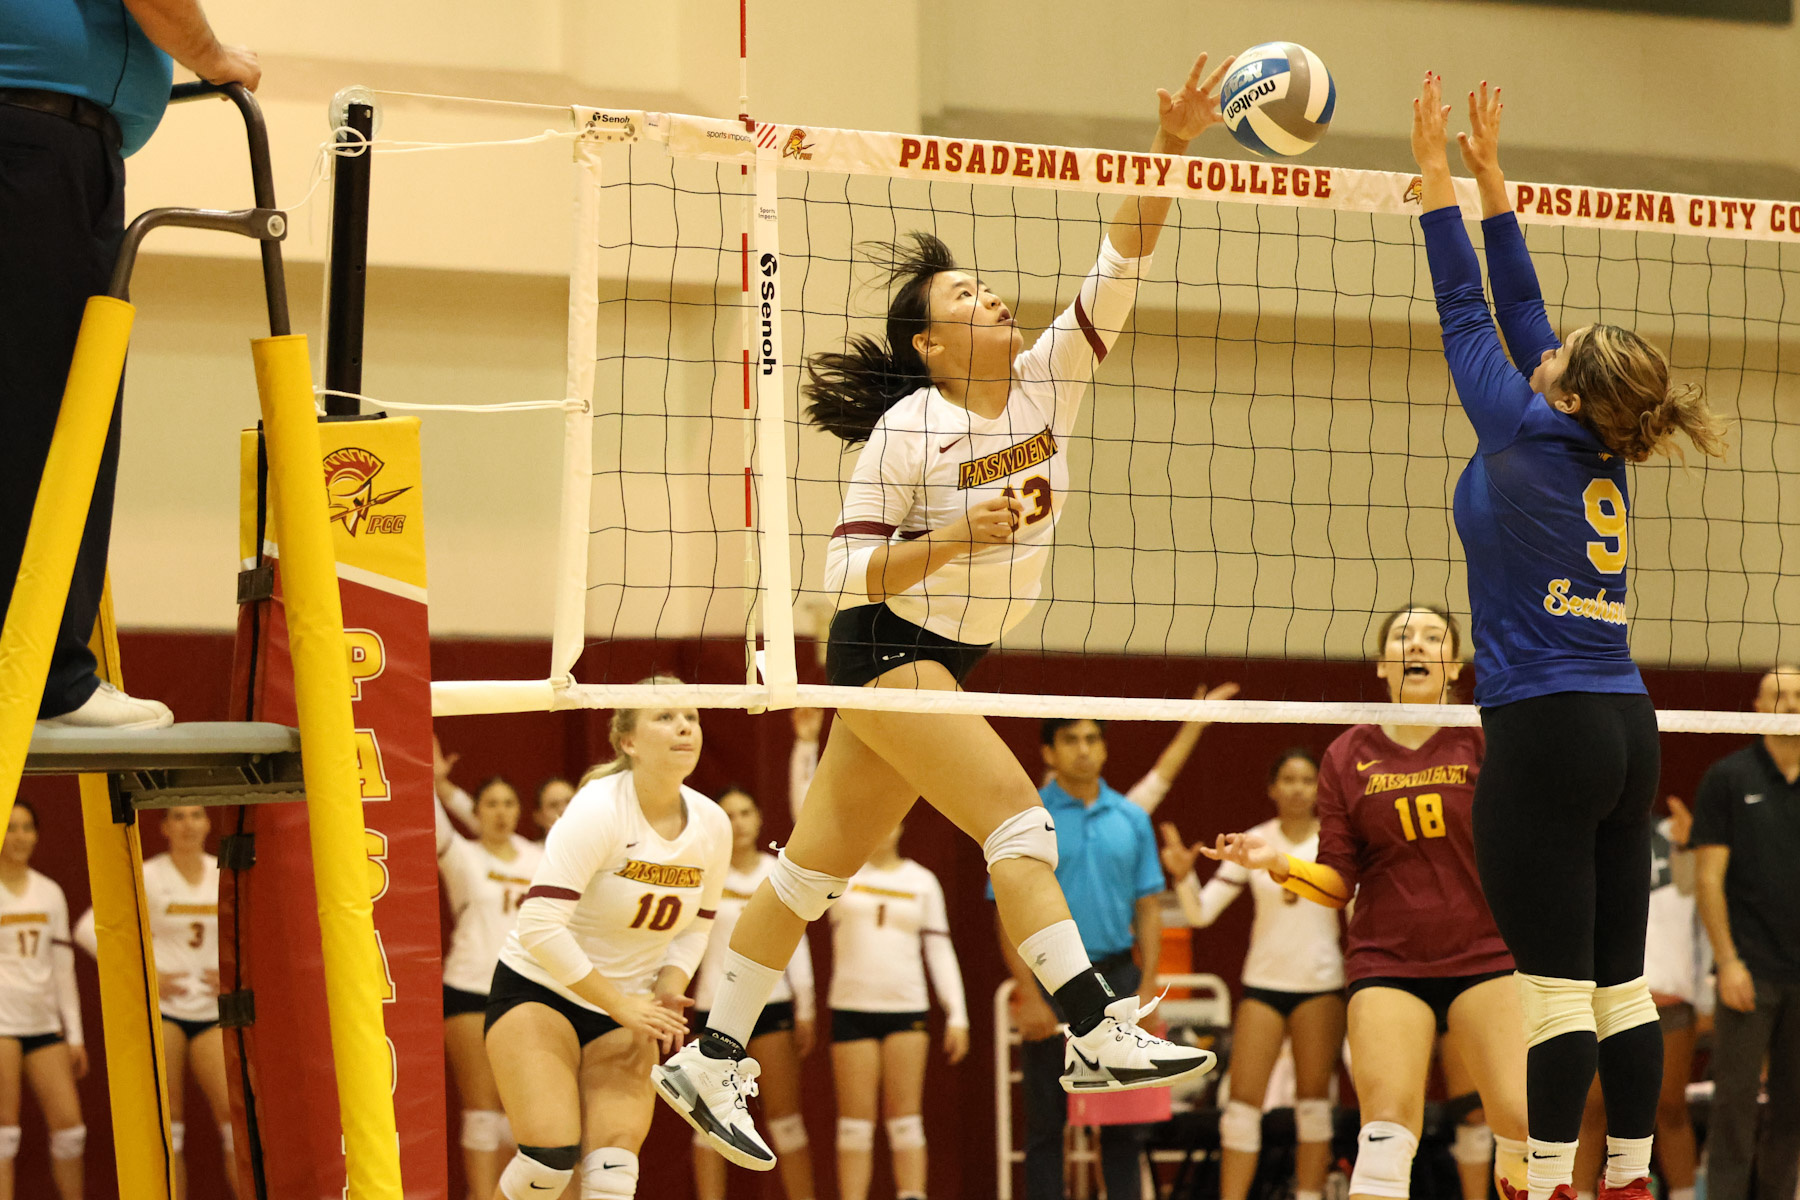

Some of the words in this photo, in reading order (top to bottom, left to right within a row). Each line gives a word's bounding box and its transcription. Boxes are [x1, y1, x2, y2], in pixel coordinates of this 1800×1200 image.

[1227, 80, 1276, 119] molten
[602, 114, 630, 123] Senoh
[899, 138, 1080, 181] PASADENA
[1095, 153, 1172, 186] CITY
[1187, 159, 1331, 198] COLLEGE
[1516, 184, 1675, 224] PASADENA
[1688, 198, 1756, 231] CITY
[761, 281, 777, 376] Senoh
[366, 514, 406, 535] PCC
[1582, 478, 1628, 574] 9
[1364, 764, 1468, 796] PASADENA
[1394, 793, 1446, 841] 18
[613, 858, 704, 888] PASADEN
[628, 892, 682, 931] 10
[876, 903, 886, 928] 1
[17, 930, 40, 958] 17
[188, 922, 205, 949] 3
